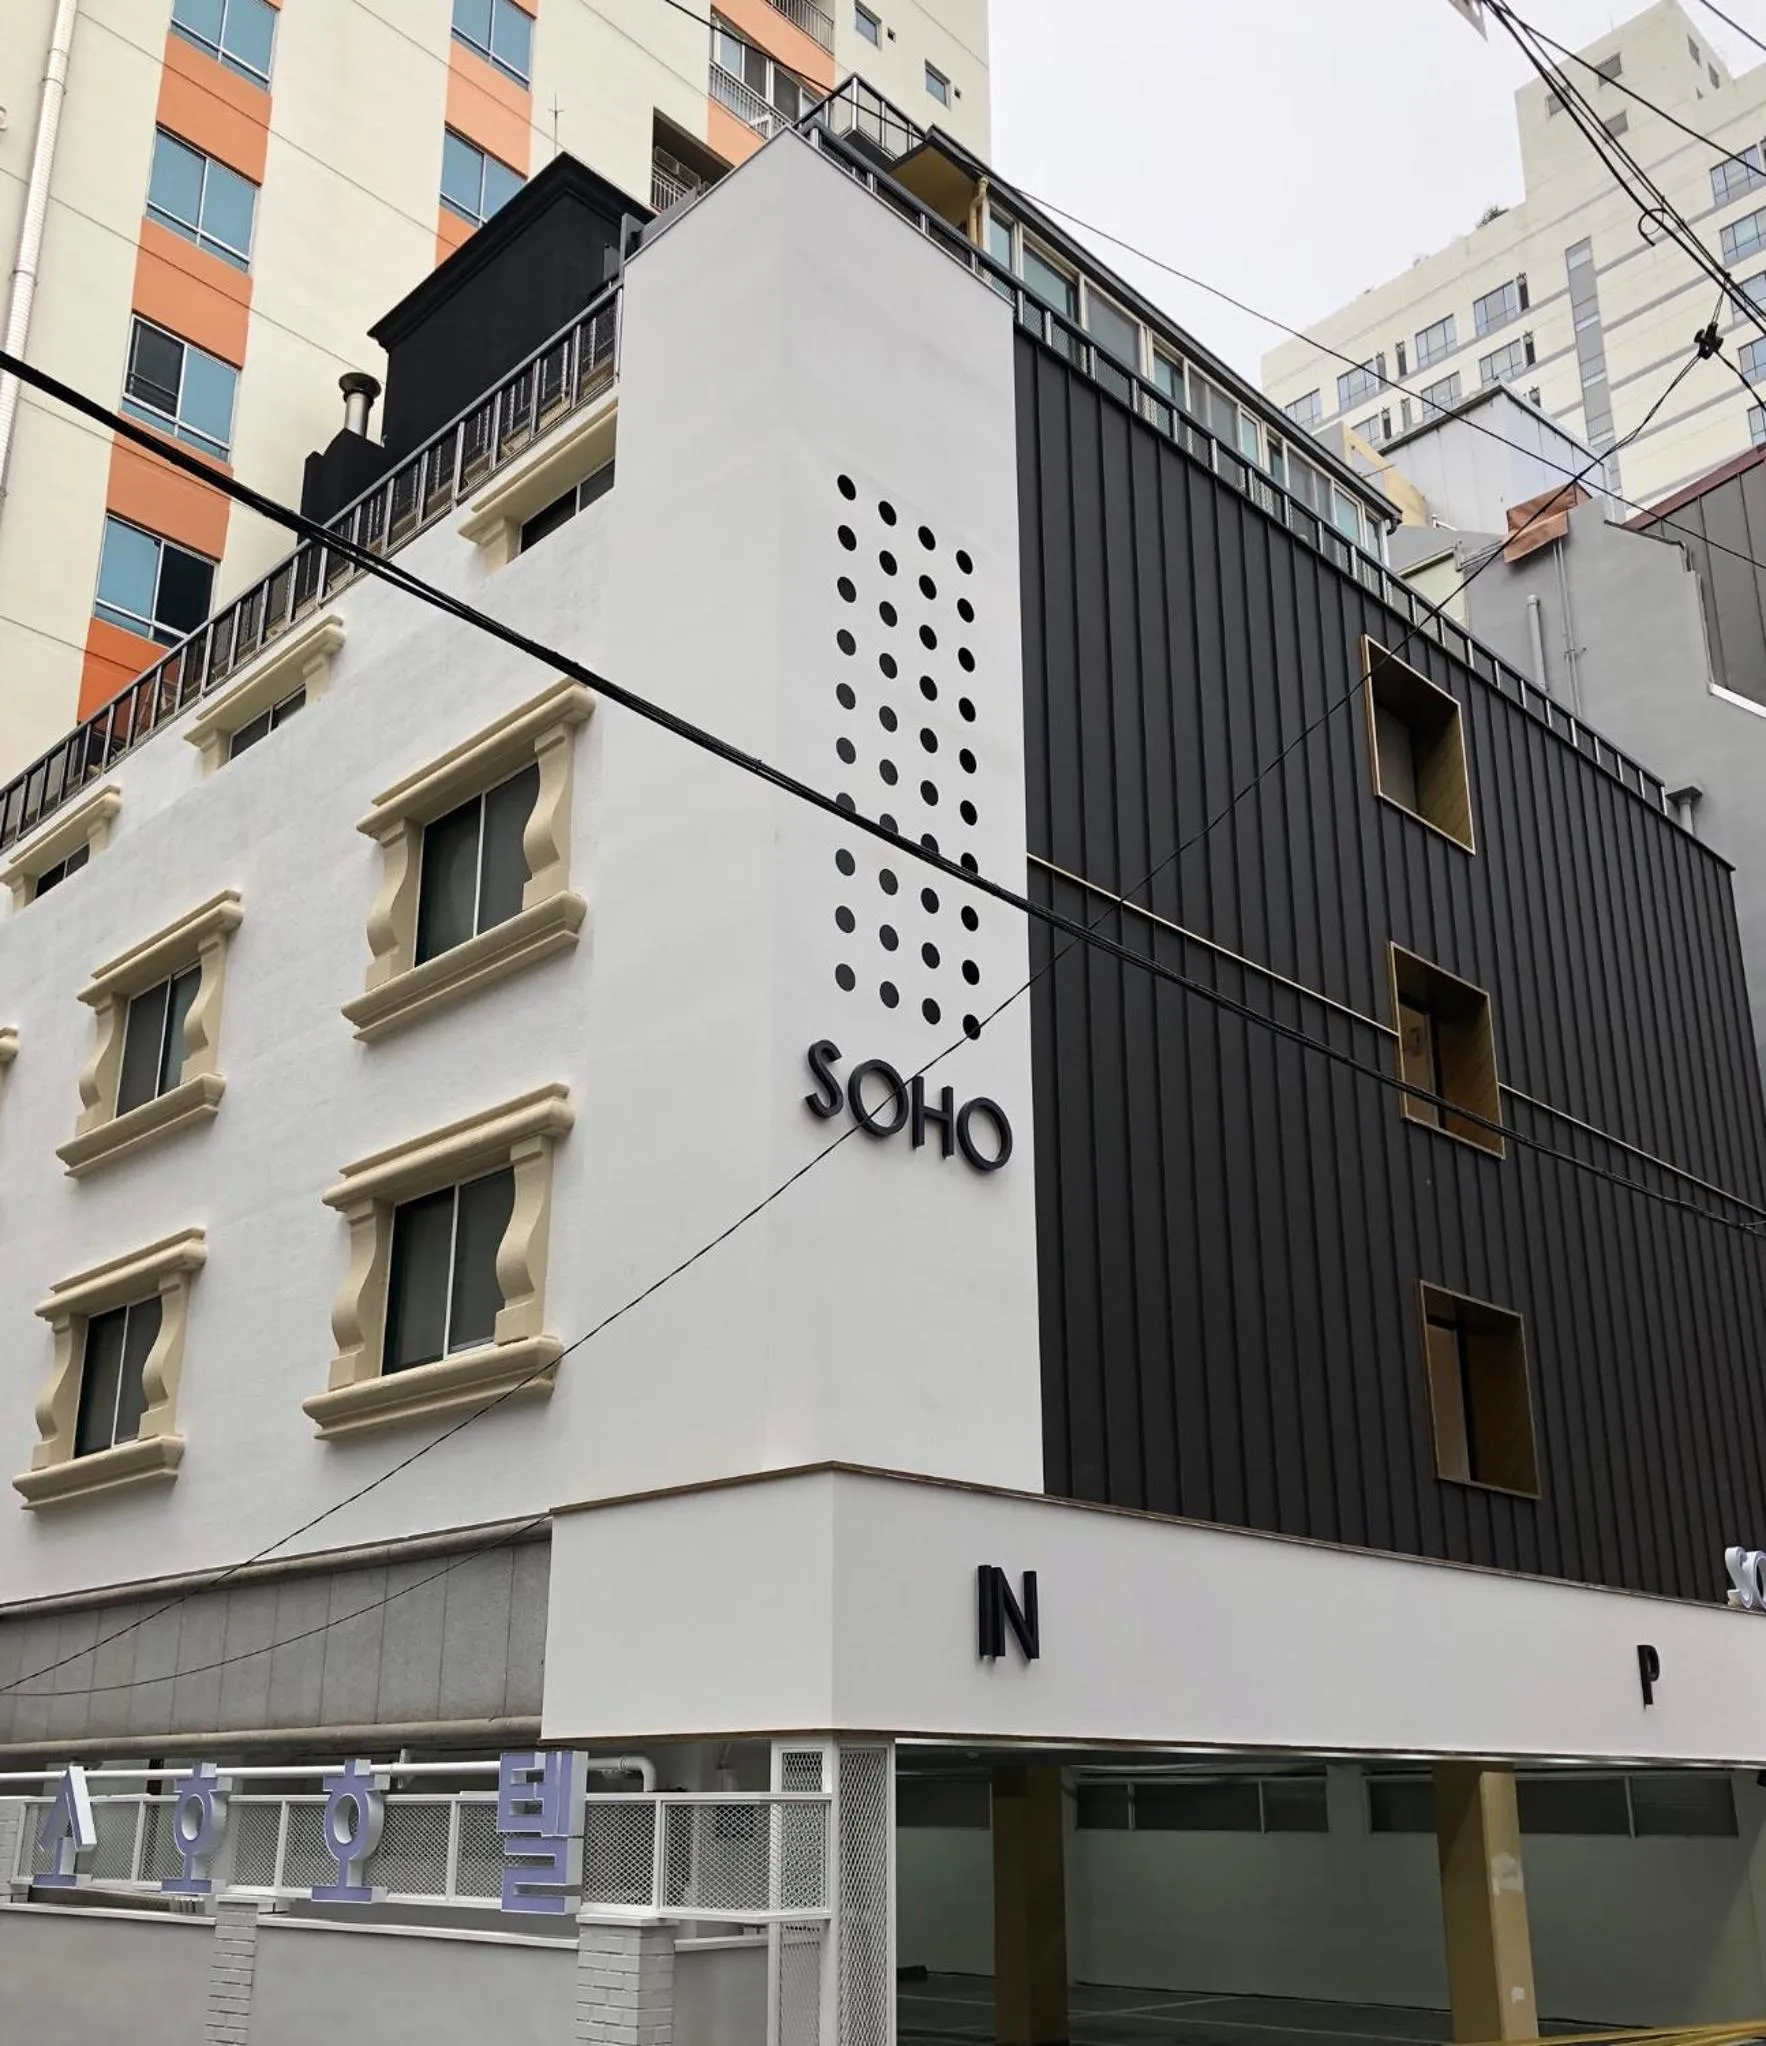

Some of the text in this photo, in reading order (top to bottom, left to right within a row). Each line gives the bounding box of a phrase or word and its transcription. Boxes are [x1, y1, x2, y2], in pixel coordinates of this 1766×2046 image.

[805, 1039, 1013, 1172] SOHO
[977, 1564, 1040, 1660] IN
[1636, 1644, 1660, 1706] P
[32, 1752, 589, 1915] 소호호텔
